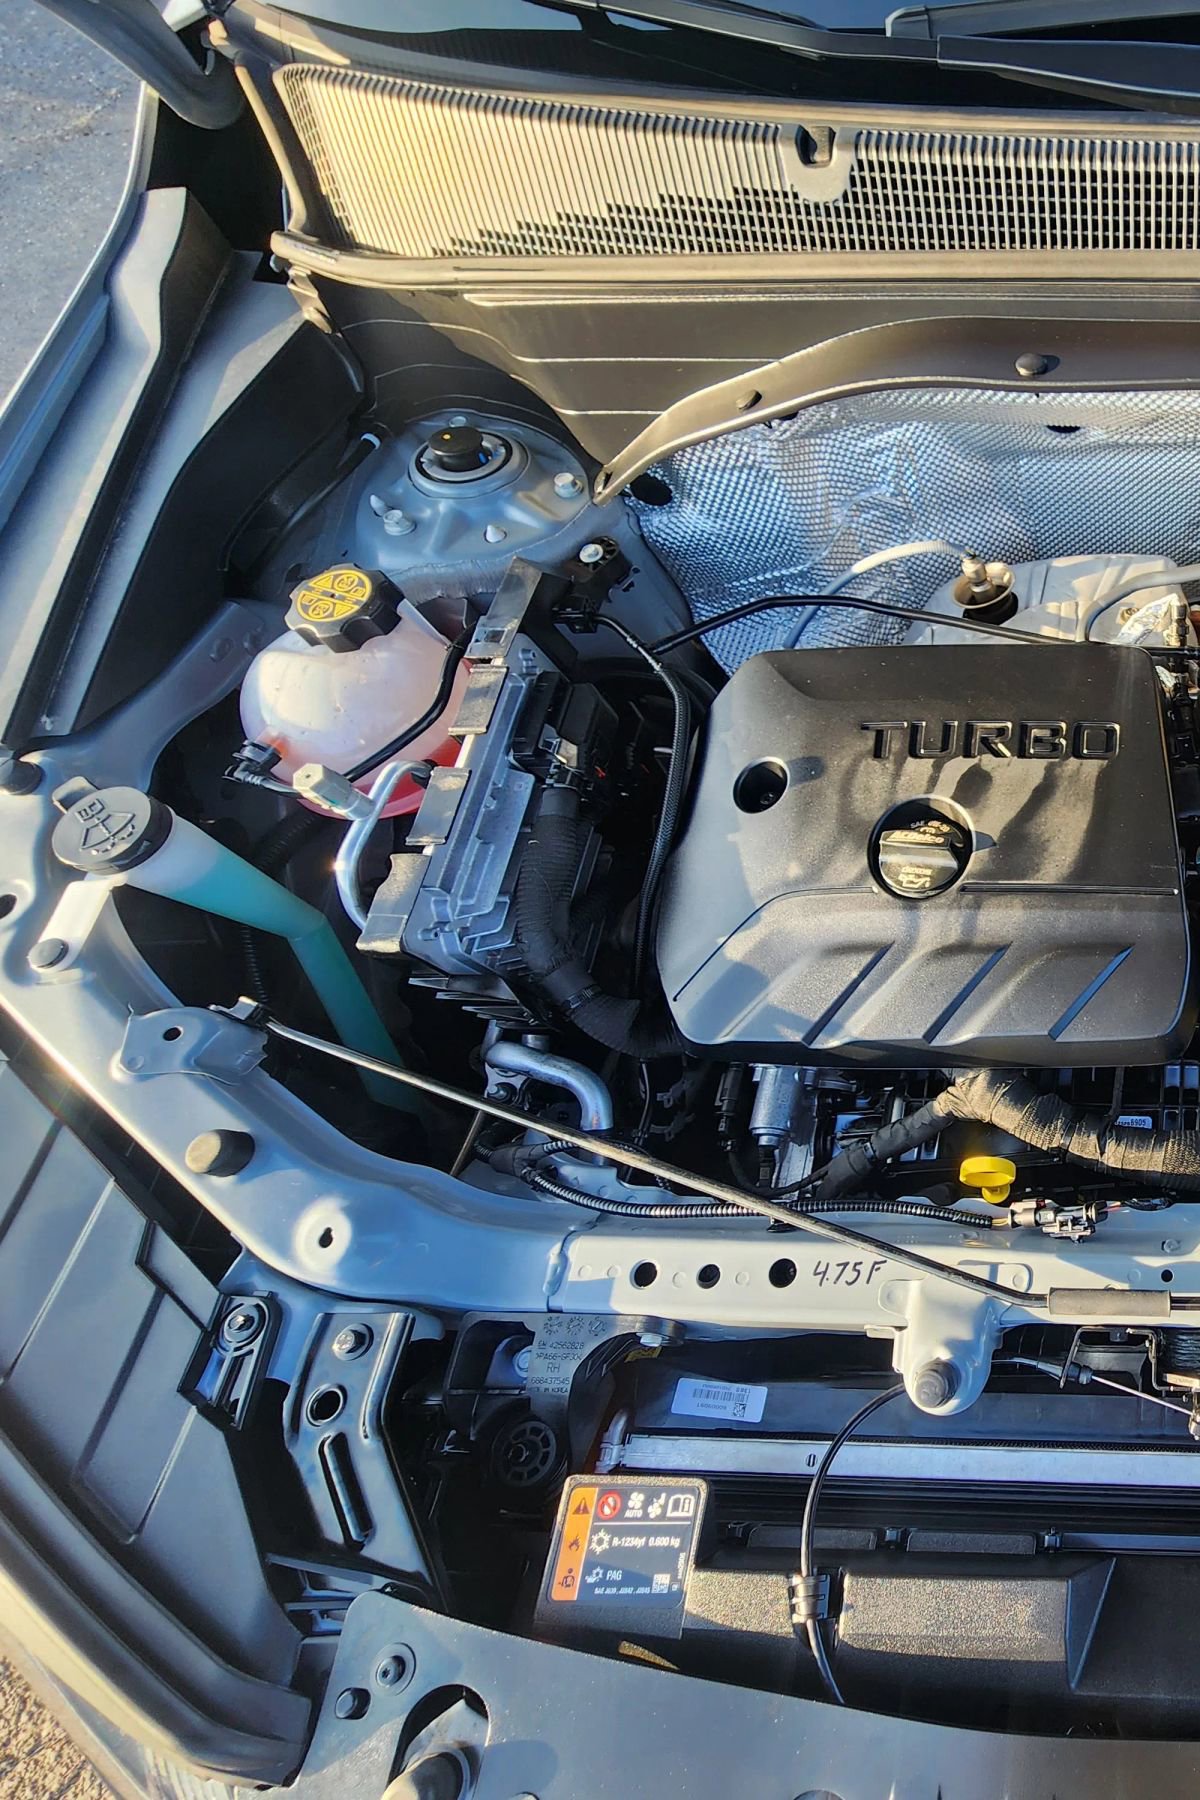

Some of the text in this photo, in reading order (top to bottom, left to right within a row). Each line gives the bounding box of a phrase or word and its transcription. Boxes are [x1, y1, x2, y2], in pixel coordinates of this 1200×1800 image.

[860, 720, 1121, 760] TURBO
[546, 1362, 560, 1374] RH
[624, 1508, 643, 1519] AUTO
[612, 1536, 646, 1549] R-1234yf
[670, 1535, 681, 1549] kg
[606, 1569, 623, 1581] PAG
